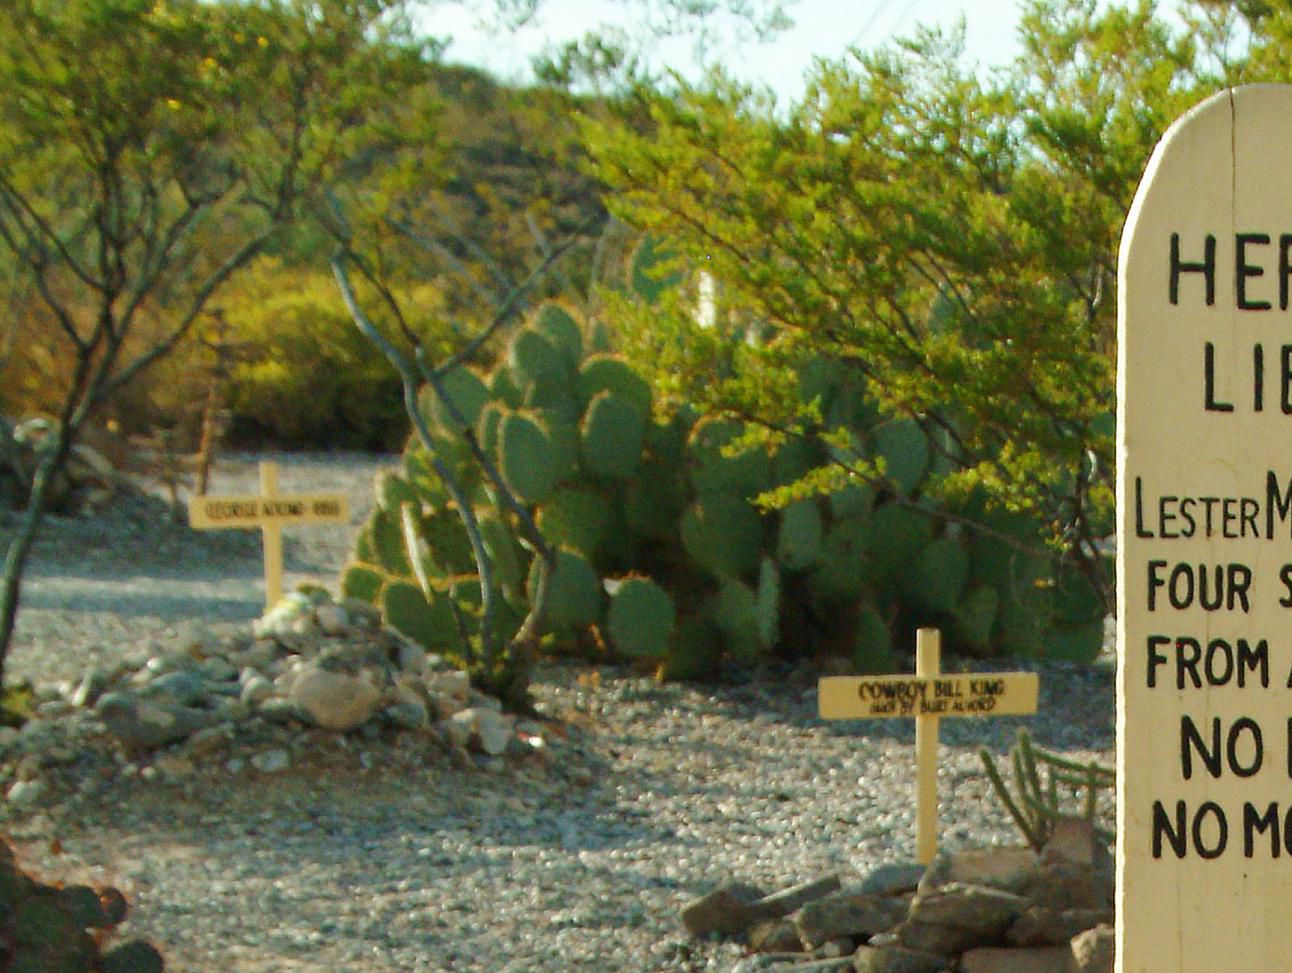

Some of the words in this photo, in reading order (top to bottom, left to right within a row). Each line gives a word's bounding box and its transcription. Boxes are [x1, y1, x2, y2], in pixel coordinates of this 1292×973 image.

[1147, 560, 1252, 613] FOUR
[858, 681, 928, 701] COWBOY
[934, 679, 962, 698] BILL
[969, 678, 1005, 696] KING
[1147, 635, 1269, 690] FROM
[1181, 715, 1264, 780] NO
[1152, 800, 1228, 860] NO
